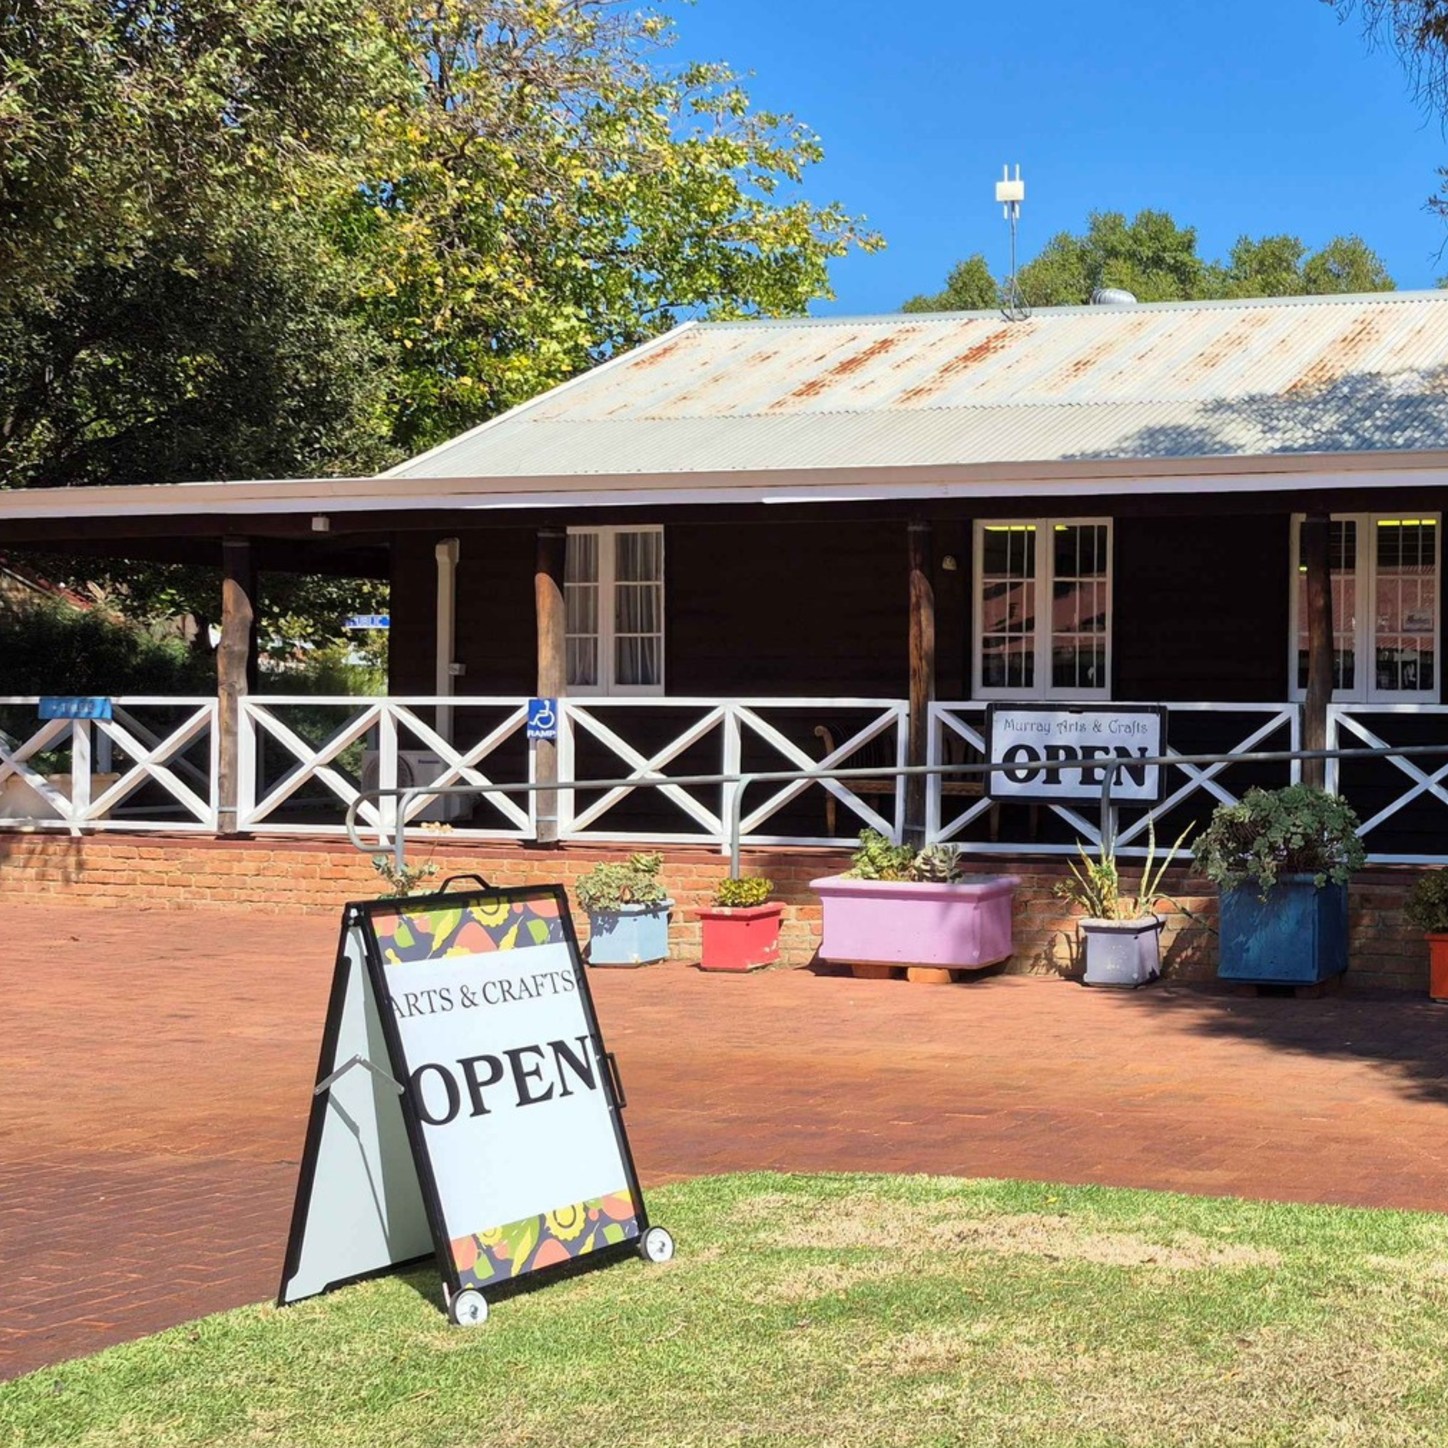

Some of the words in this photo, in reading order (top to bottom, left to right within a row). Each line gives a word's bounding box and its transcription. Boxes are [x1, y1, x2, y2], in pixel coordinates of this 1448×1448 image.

[528, 730, 557, 738] RAMP
[1003, 718, 1051, 736] Murray
[1056, 719, 1087, 735] Arts
[1092, 719, 1102, 733] &
[1108, 718, 1149, 737] Crafts
[1002, 743, 1149, 787] OPEN
[390, 987, 454, 1019] ARTS
[460, 984, 480, 1009] &
[482, 969, 576, 1006] CRAFTS
[409, 1035, 597, 1126] OPEN
